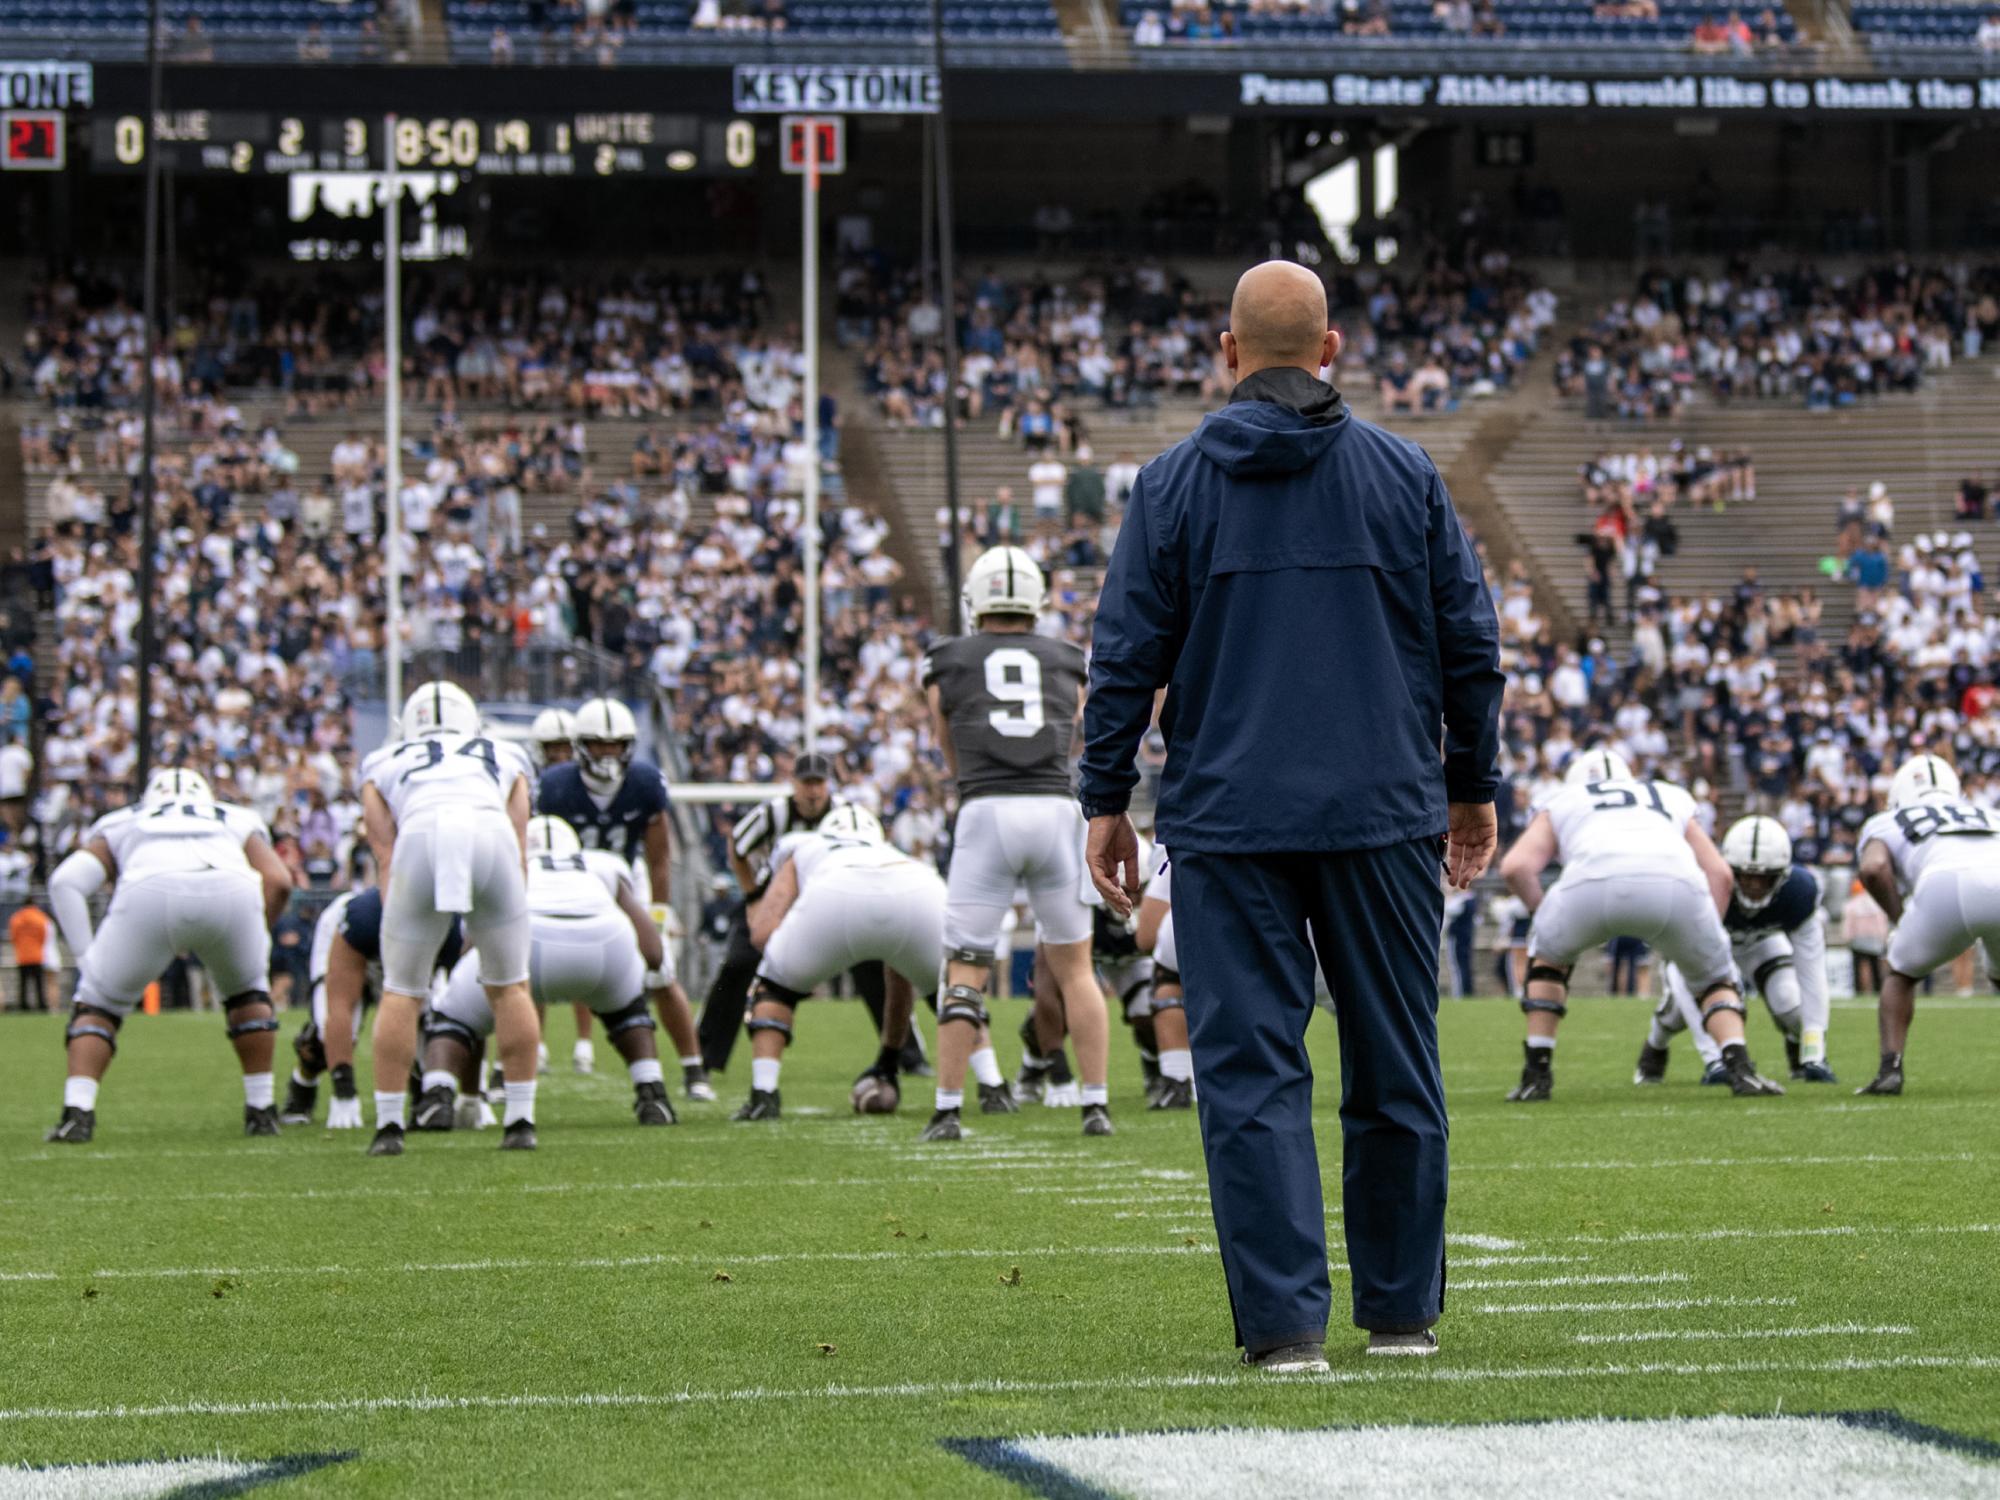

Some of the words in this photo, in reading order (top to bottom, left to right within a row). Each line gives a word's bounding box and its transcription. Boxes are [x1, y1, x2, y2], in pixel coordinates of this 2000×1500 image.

[739, 73, 940, 102] KEYSTONE
[1240, 73, 1329, 105] Penn
[1436, 74, 1590, 106] Athletics
[1593, 76, 1698, 107] would
[1701, 76, 1767, 108] like
[1771, 78, 1809, 108] to
[1814, 78, 1912, 108] thank
[1917, 79, 1974, 109] the
[115, 115, 145, 165] 0
[279, 117, 304, 157] 2
[344, 117, 367, 157] 3
[726, 119, 755, 168] 0
[984, 648, 1044, 737] 9
[393, 737, 500, 784] 34
[1585, 780, 1673, 822] 51
